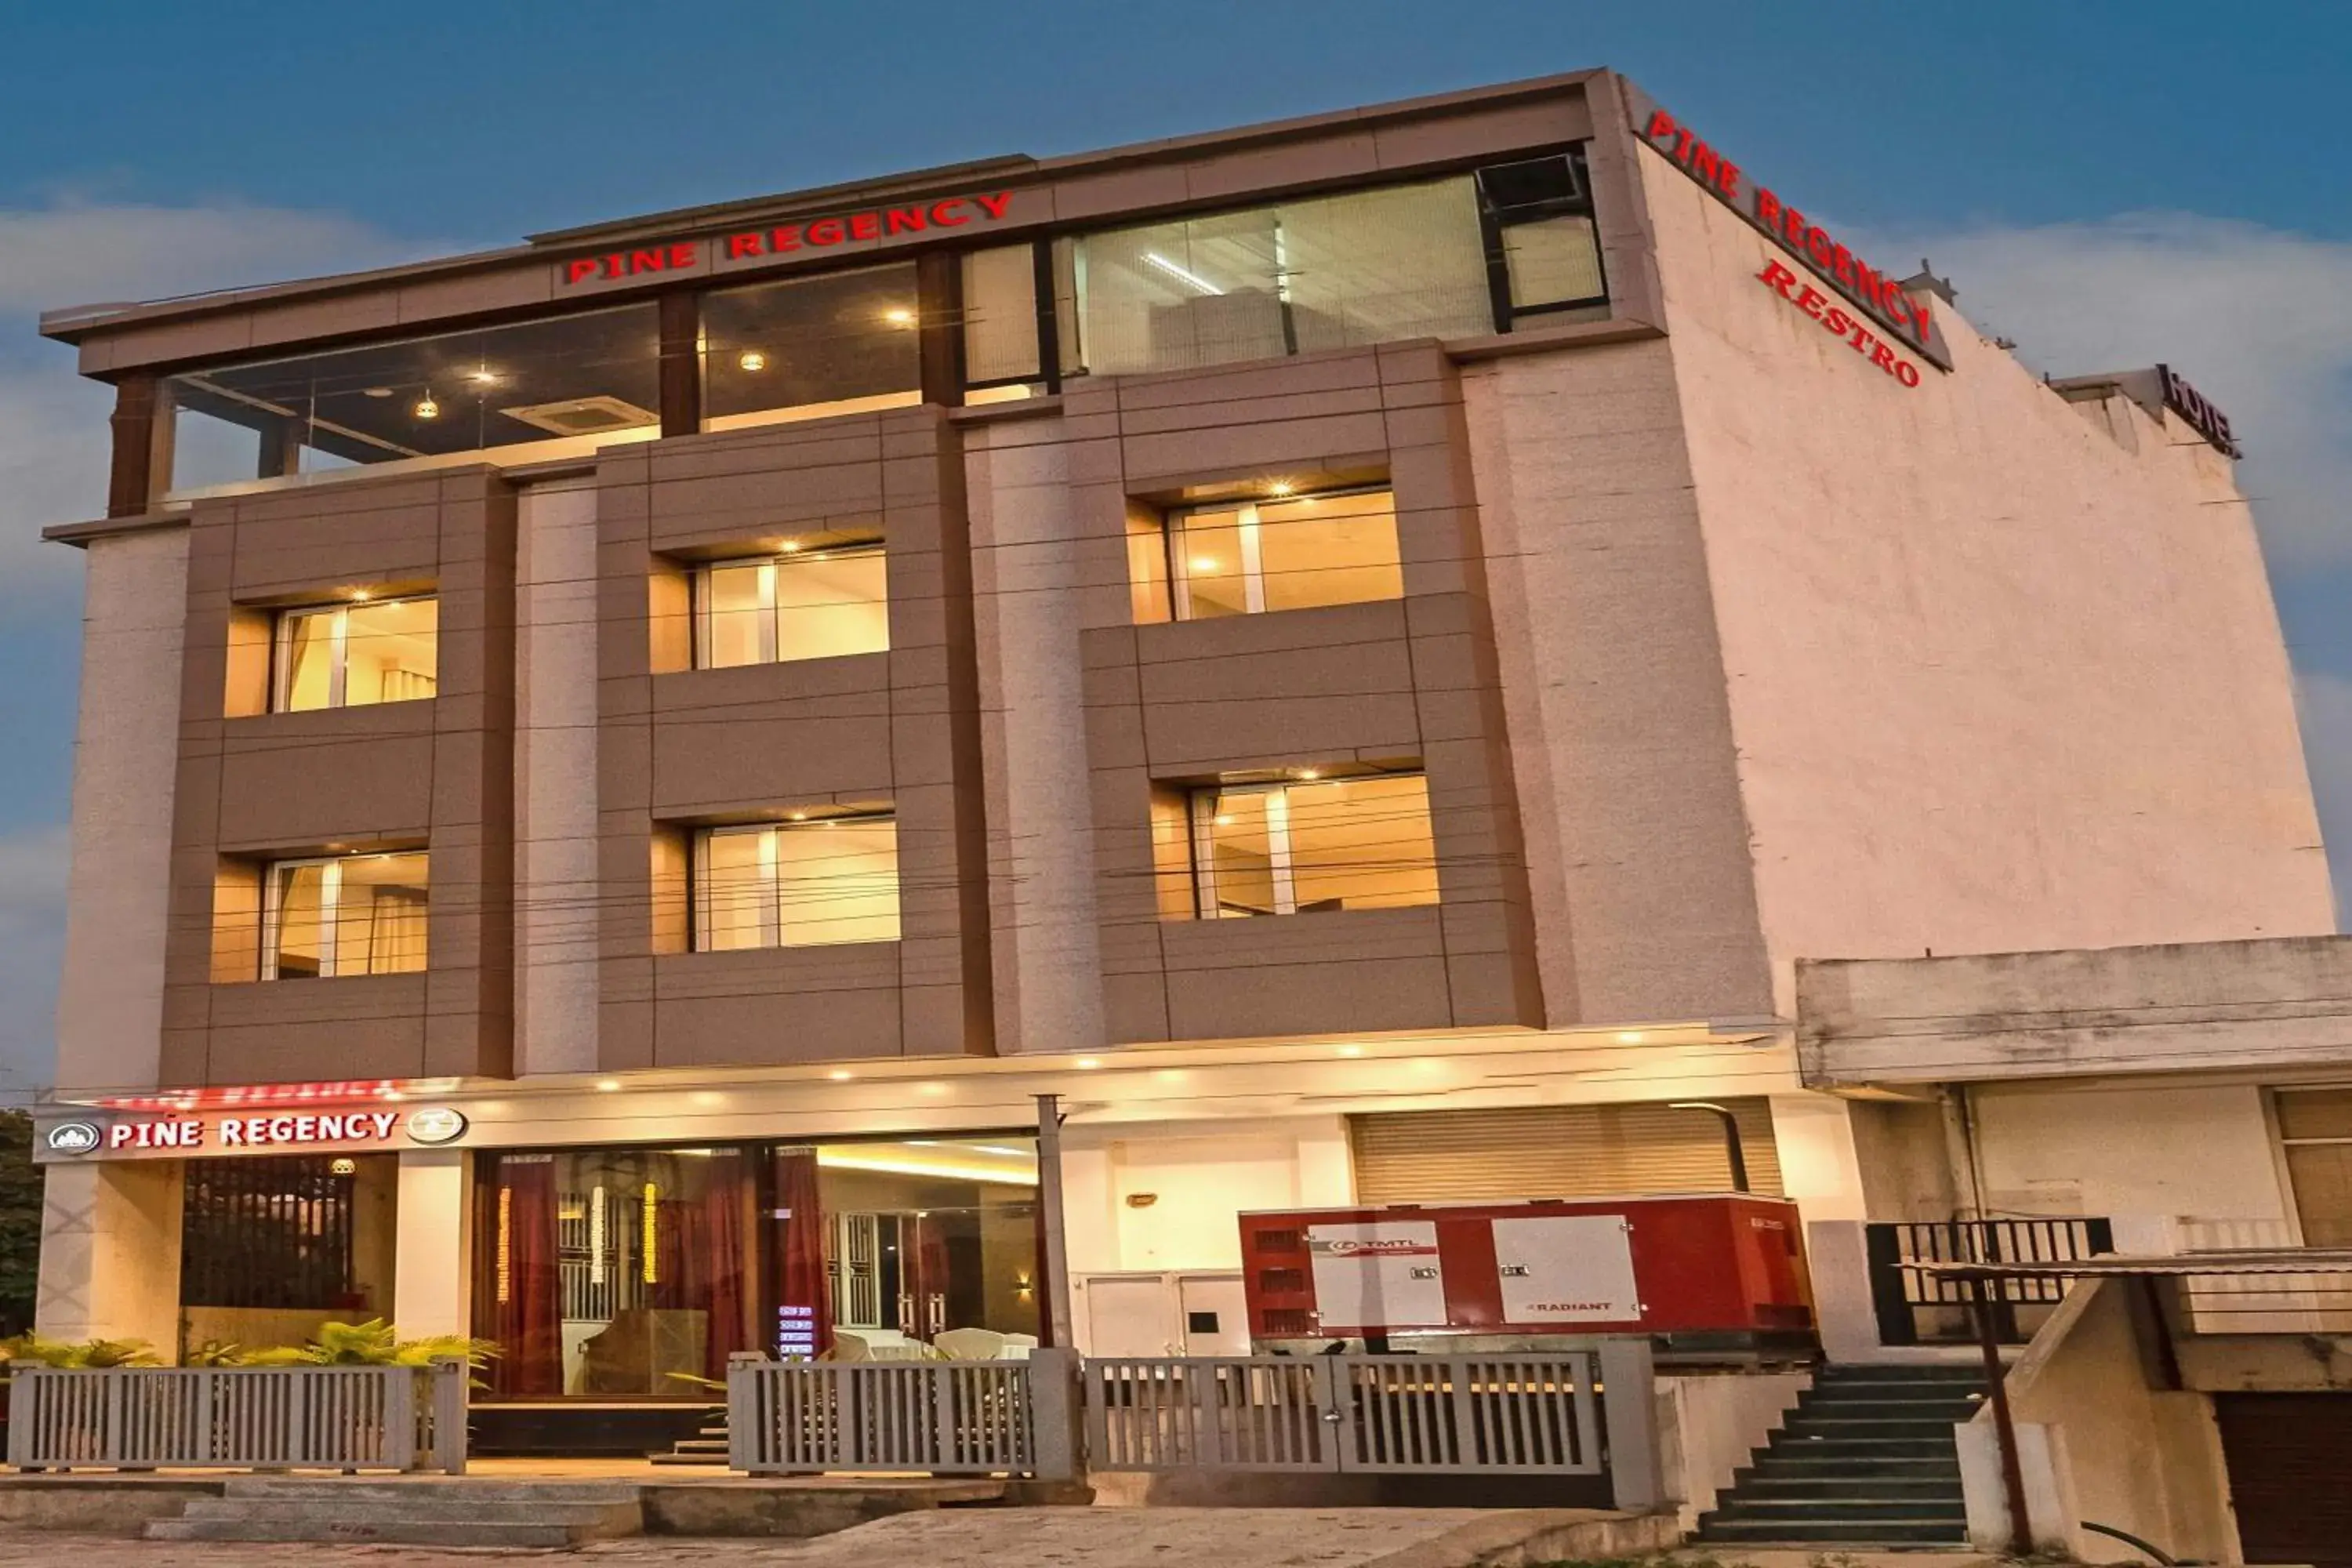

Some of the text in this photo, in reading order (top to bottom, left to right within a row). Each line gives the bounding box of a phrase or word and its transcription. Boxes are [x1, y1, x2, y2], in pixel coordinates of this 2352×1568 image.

[569, 191, 1014, 285] PINE REGENCY
[1650, 108, 1931, 343] PINE REGENCY
[1754, 258, 1920, 388] RESTRO
[111, 1112, 397, 1149] PINE REGENCY
[1536, 1302, 1613, 1312] RADIANT
